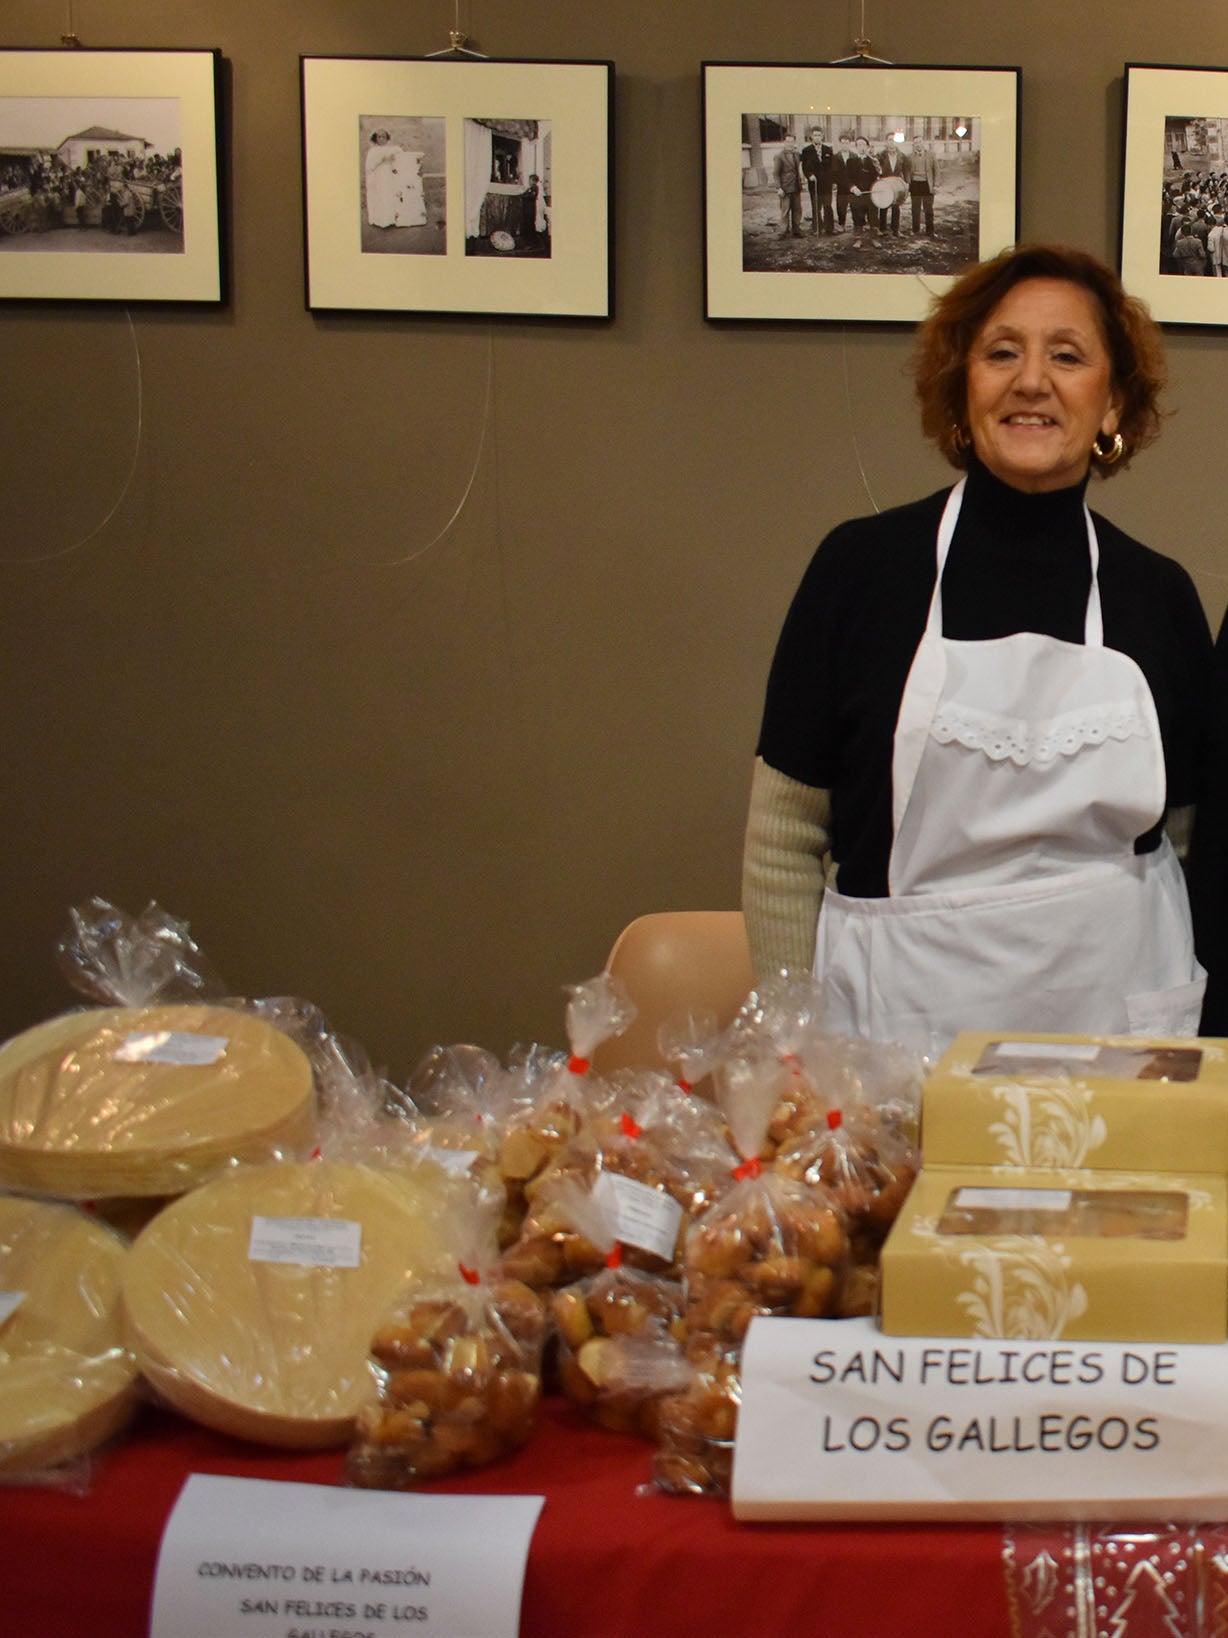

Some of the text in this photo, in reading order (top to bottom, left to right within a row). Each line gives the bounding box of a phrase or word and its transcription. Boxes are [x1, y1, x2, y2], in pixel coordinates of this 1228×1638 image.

[809, 1349, 1178, 1386] SAN FELICES DE
[822, 1414, 1160, 1453] LOS GALLEGOS
[198, 1561, 431, 1587] CONVENTO DE LA PASIÓN
[240, 1599, 429, 1621] SAN FELICES DE LOS
